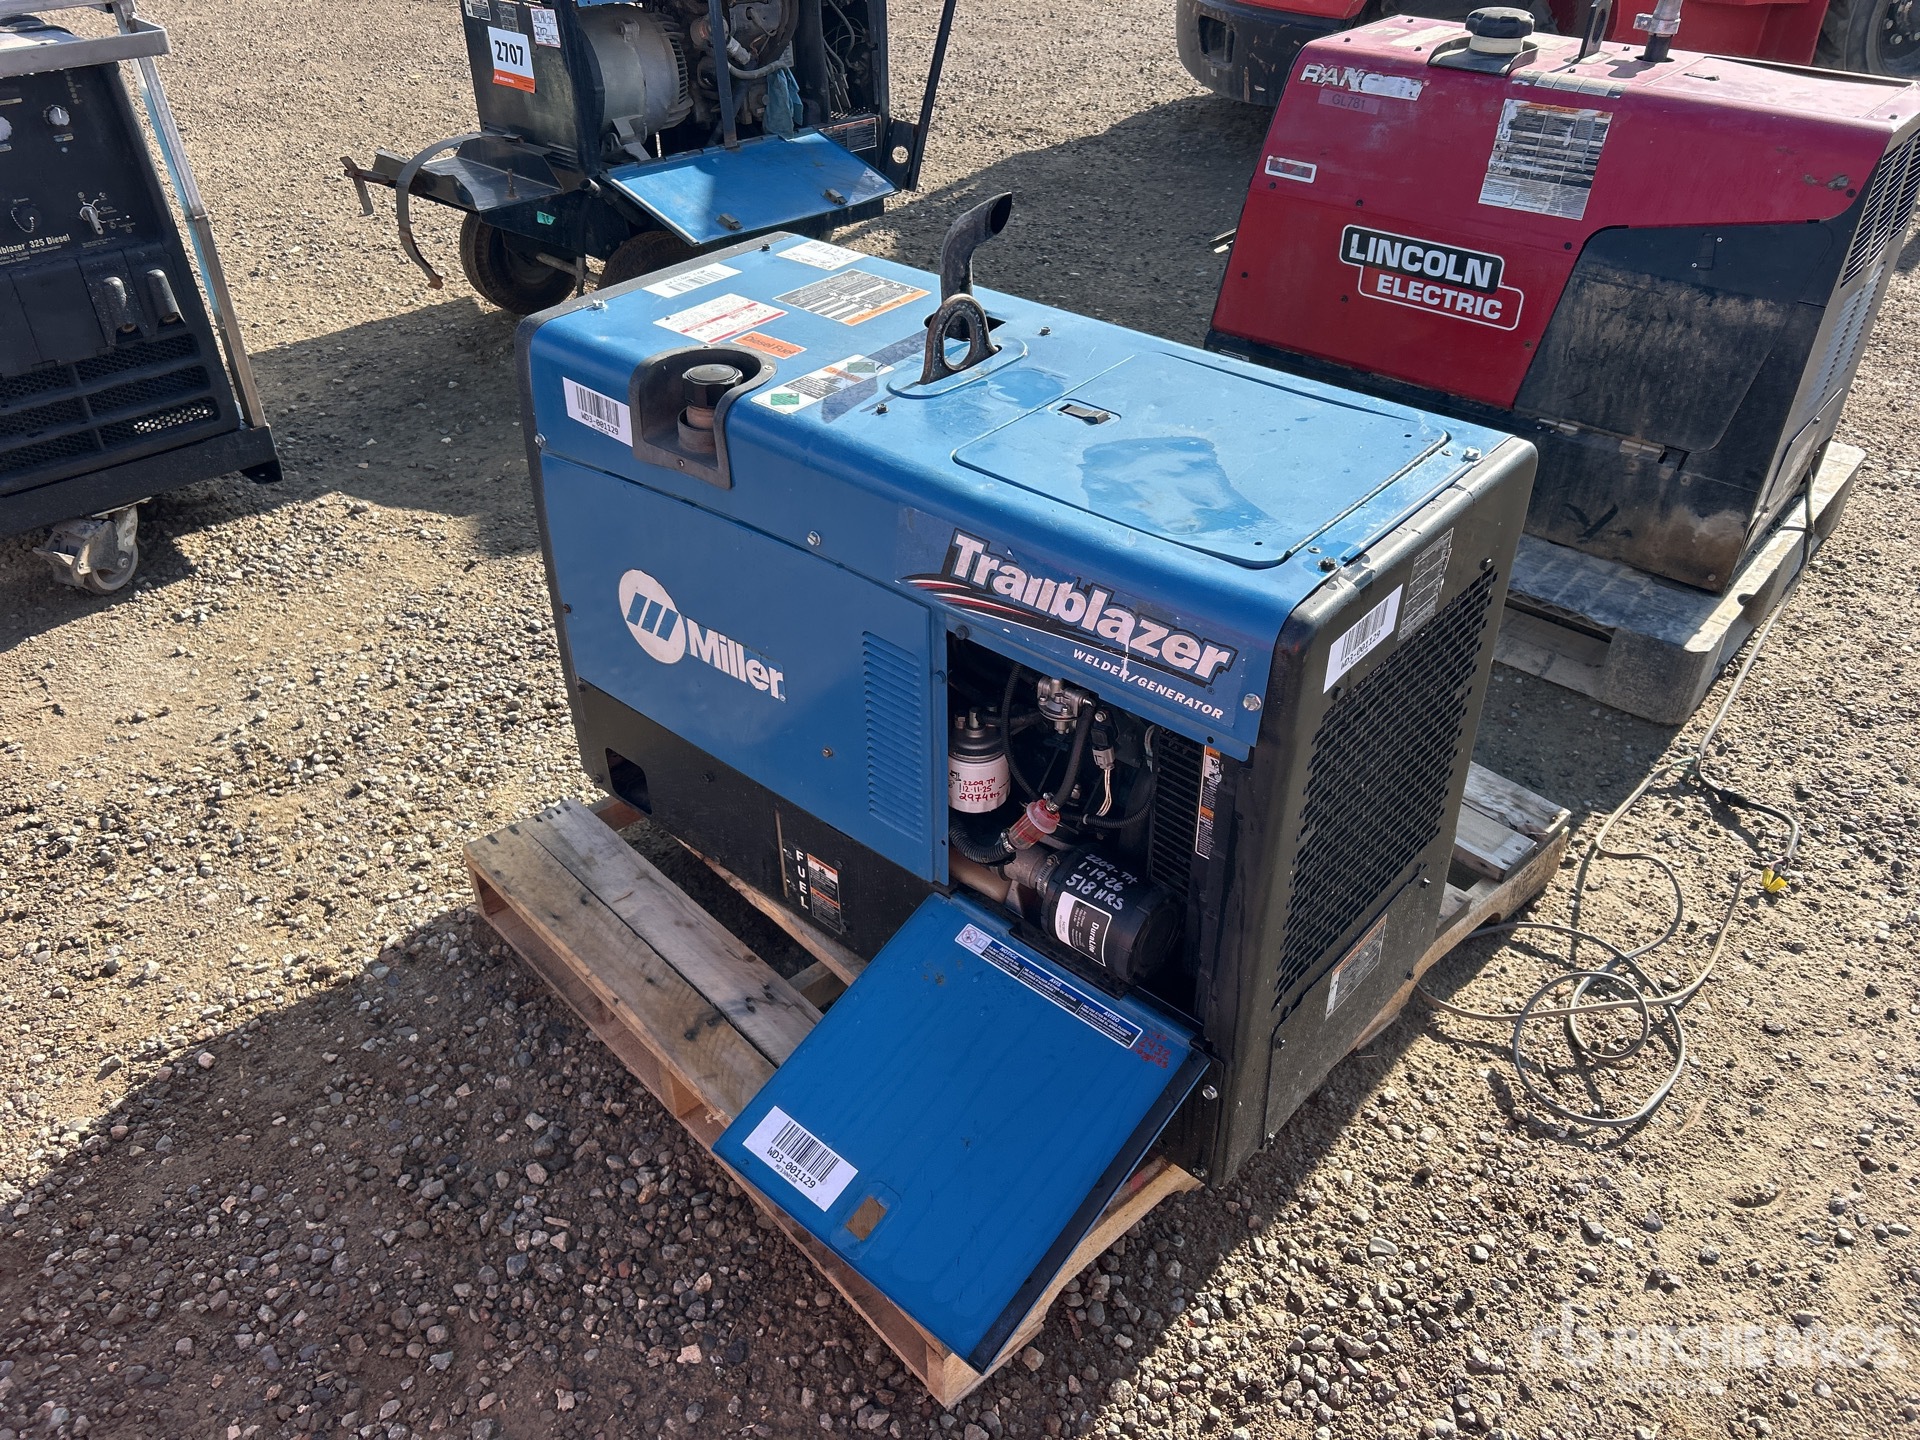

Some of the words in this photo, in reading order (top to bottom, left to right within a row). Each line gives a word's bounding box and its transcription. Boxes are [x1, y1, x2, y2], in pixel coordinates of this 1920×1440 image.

[494, 40, 524, 67] 2707
[1331, 93, 1366, 110] GL781
[28, 238, 46, 249] 325
[45, 233, 71, 246] Diesel
[1349, 233, 1493, 288] LINCOLN
[1376, 273, 1503, 320] ELECTRIC
[742, 335, 776, 348] Diesel
[771, 344, 797, 355] Fuel
[580, 411, 619, 436] WD3-001129
[686, 617, 784, 700] Miller
[1340, 629, 1381, 671] WD3-001129
[959, 792, 988, 802] 2974
[795, 849, 809, 910] FUEL
[1065, 873, 1098, 895] 518
[1093, 888, 1125, 911] HRS
[1088, 921, 1100, 954] DuraLite
[999, 946, 1019, 960] NOTICE
[1049, 977, 1062, 988] AVIS
[1102, 1010, 1121, 1023] AVISO
[766, 1146, 817, 1190] WD3-001129
